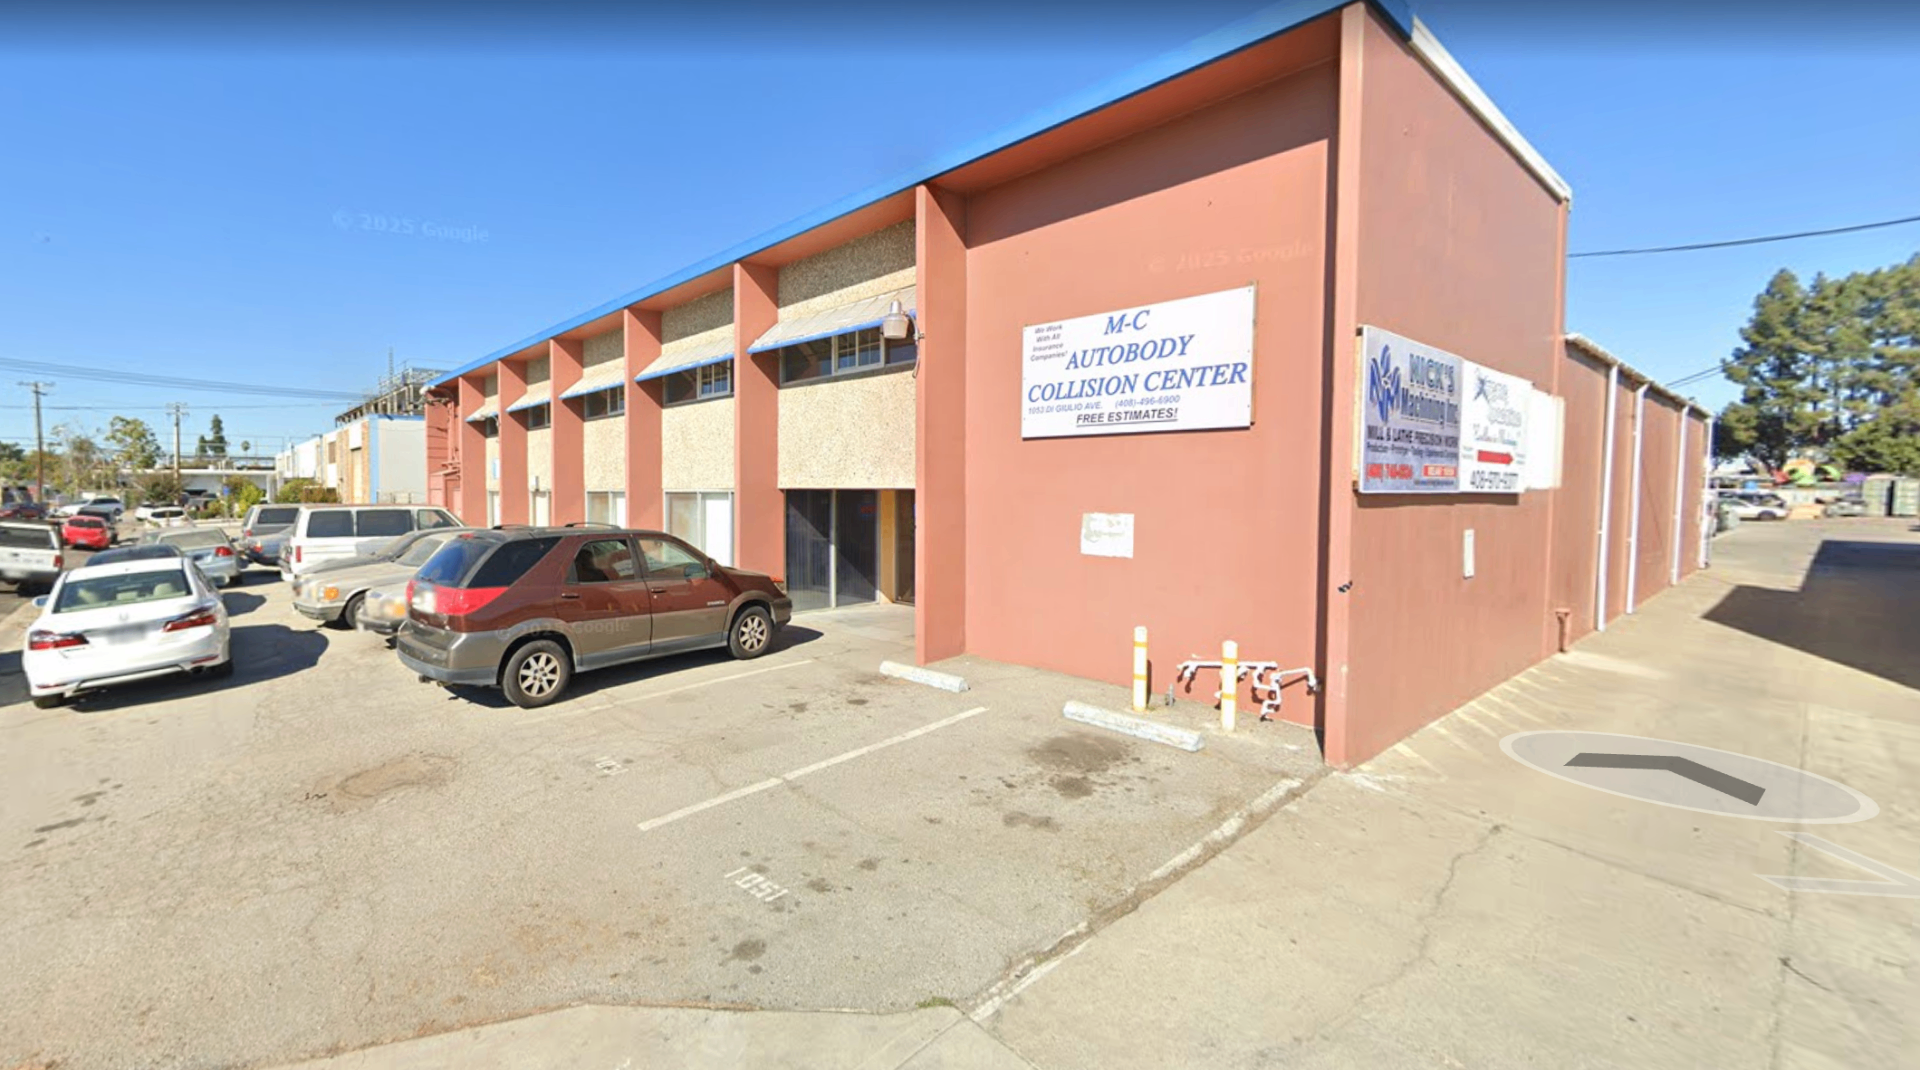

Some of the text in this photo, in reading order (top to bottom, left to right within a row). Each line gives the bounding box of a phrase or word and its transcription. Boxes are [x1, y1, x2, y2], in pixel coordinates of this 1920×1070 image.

[1046, 324, 1062, 333] Work
[1103, 310, 1151, 336] M-C
[1036, 333, 1061, 343] With All
[1032, 342, 1064, 352] Insurance
[1065, 334, 1196, 370] AUTOBODY
[1028, 362, 1248, 403] COLLISION CENTER
[1028, 405, 1045, 415] 1053
[1046, 405, 1054, 413] DI
[1055, 403, 1083, 413] GIULIO
[1084, 402, 1103, 411] AVE.
[1076, 407, 1179, 424] FREE ESTIMATES!
[1366, 425, 1384, 440] MILL
[1393, 427, 1412, 443] LATHE
[724, 866, 789, 903] 1051
